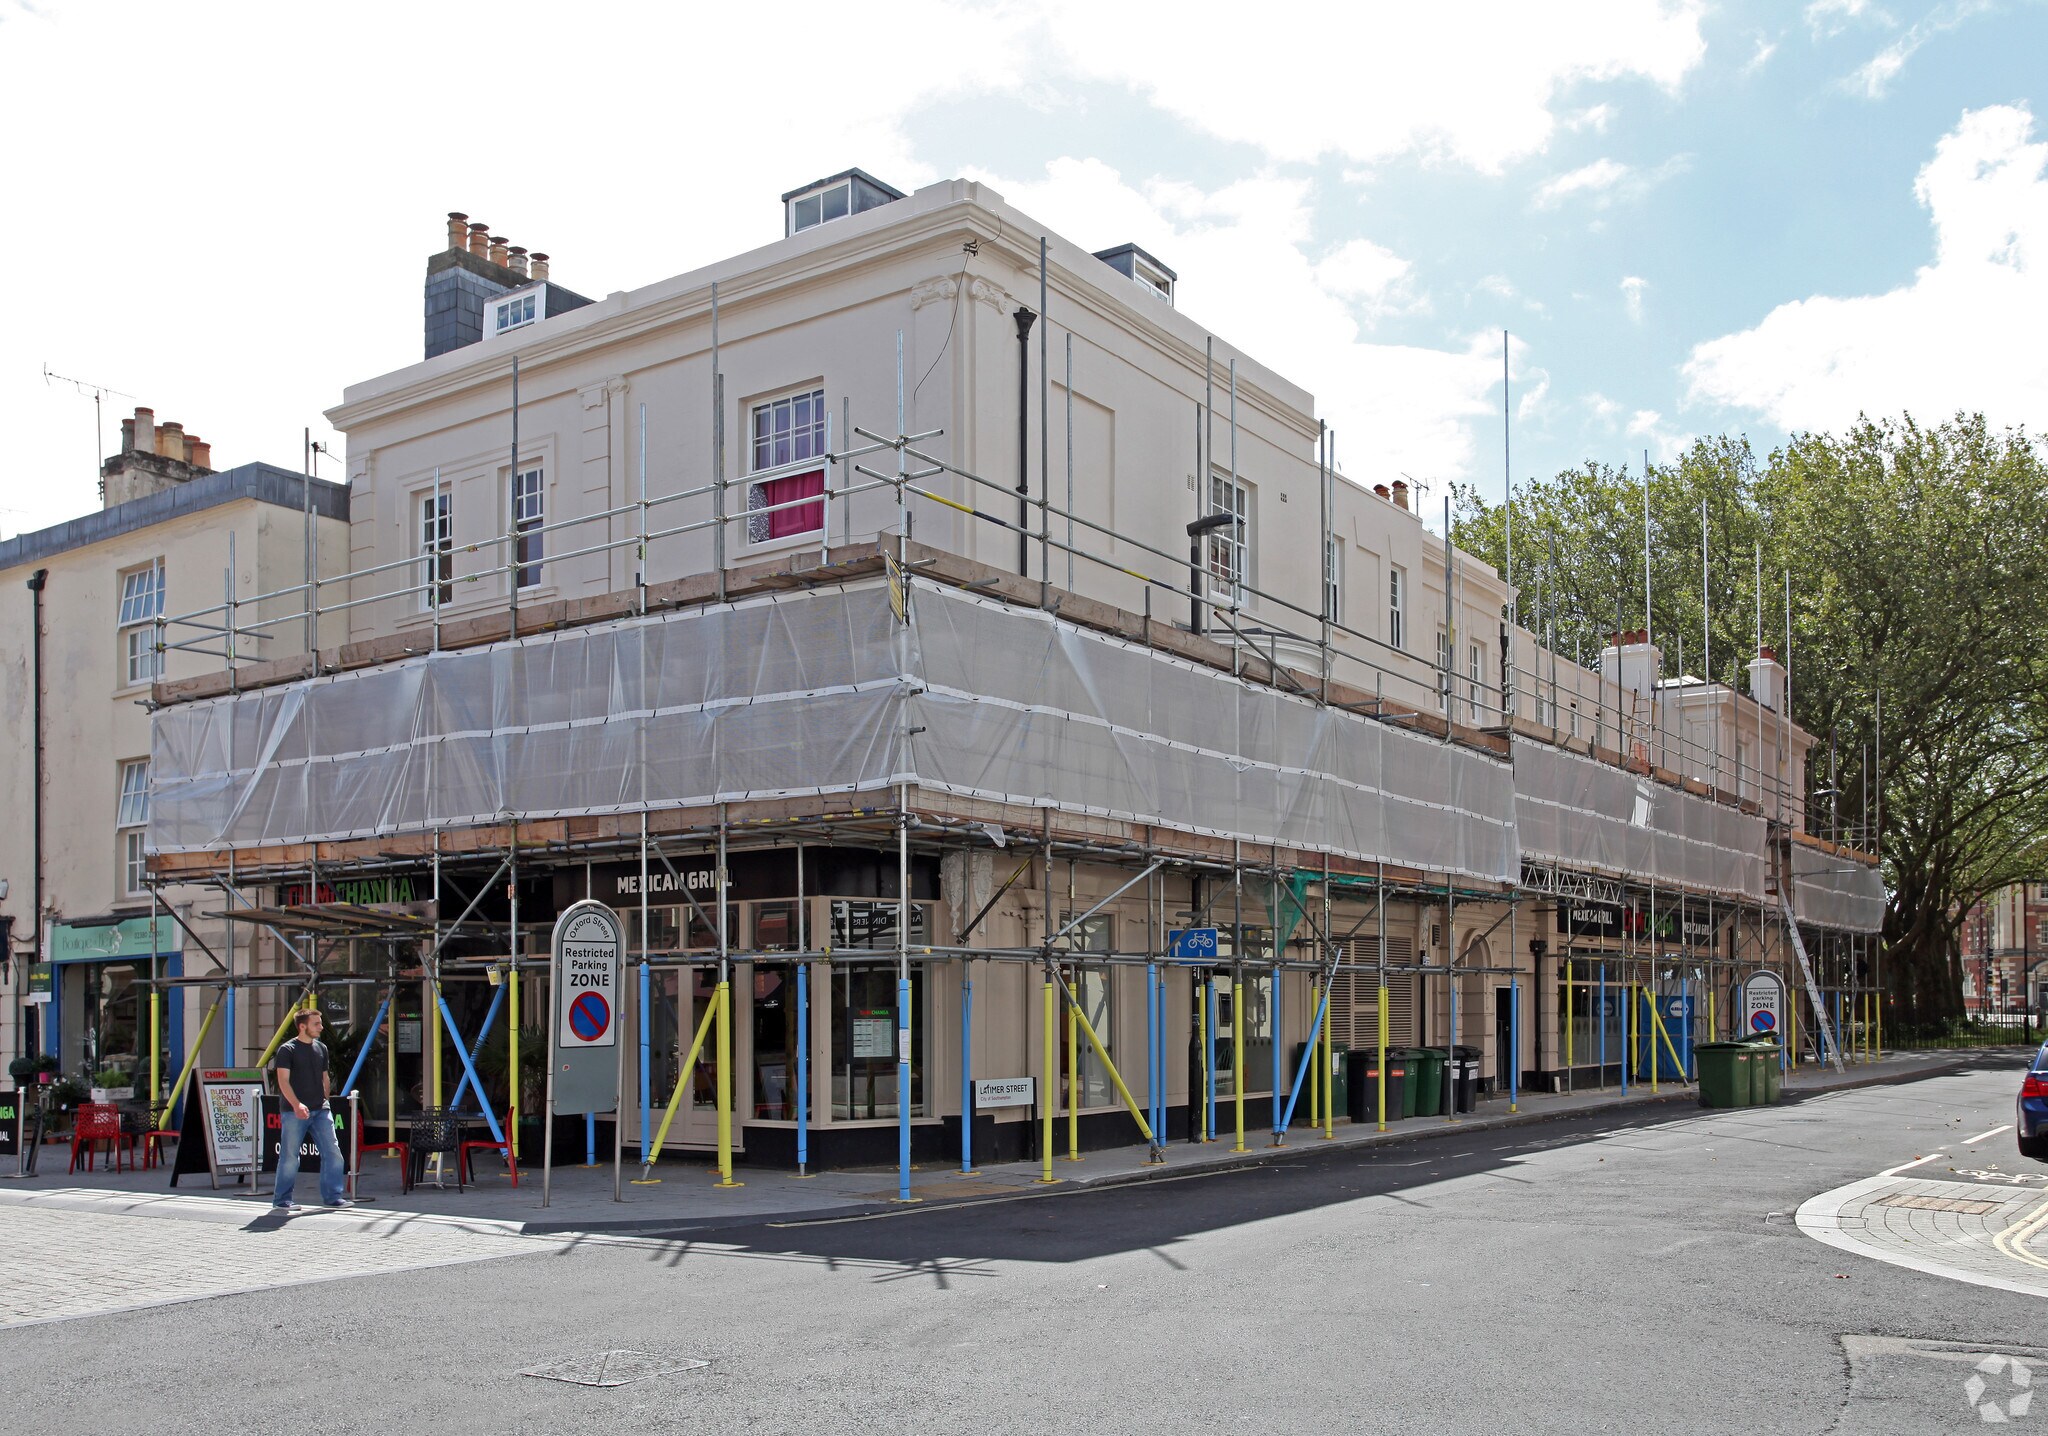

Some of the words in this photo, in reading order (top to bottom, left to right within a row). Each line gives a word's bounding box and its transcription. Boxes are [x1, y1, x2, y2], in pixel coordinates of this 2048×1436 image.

[688, 869, 733, 890] GRIL
[288, 877, 413, 905] CHMICHANGA
[569, 916, 591, 938] Oxford
[592, 916, 610, 939] Street
[1624, 910, 1674, 933] CHMICHANGA
[566, 948, 614, 958] Restricted
[572, 960, 607, 971] Parking
[571, 974, 609, 986] ZONE
[980, 1084, 1004, 1095] LATIMER
[1006, 1084, 1027, 1093] STREET
